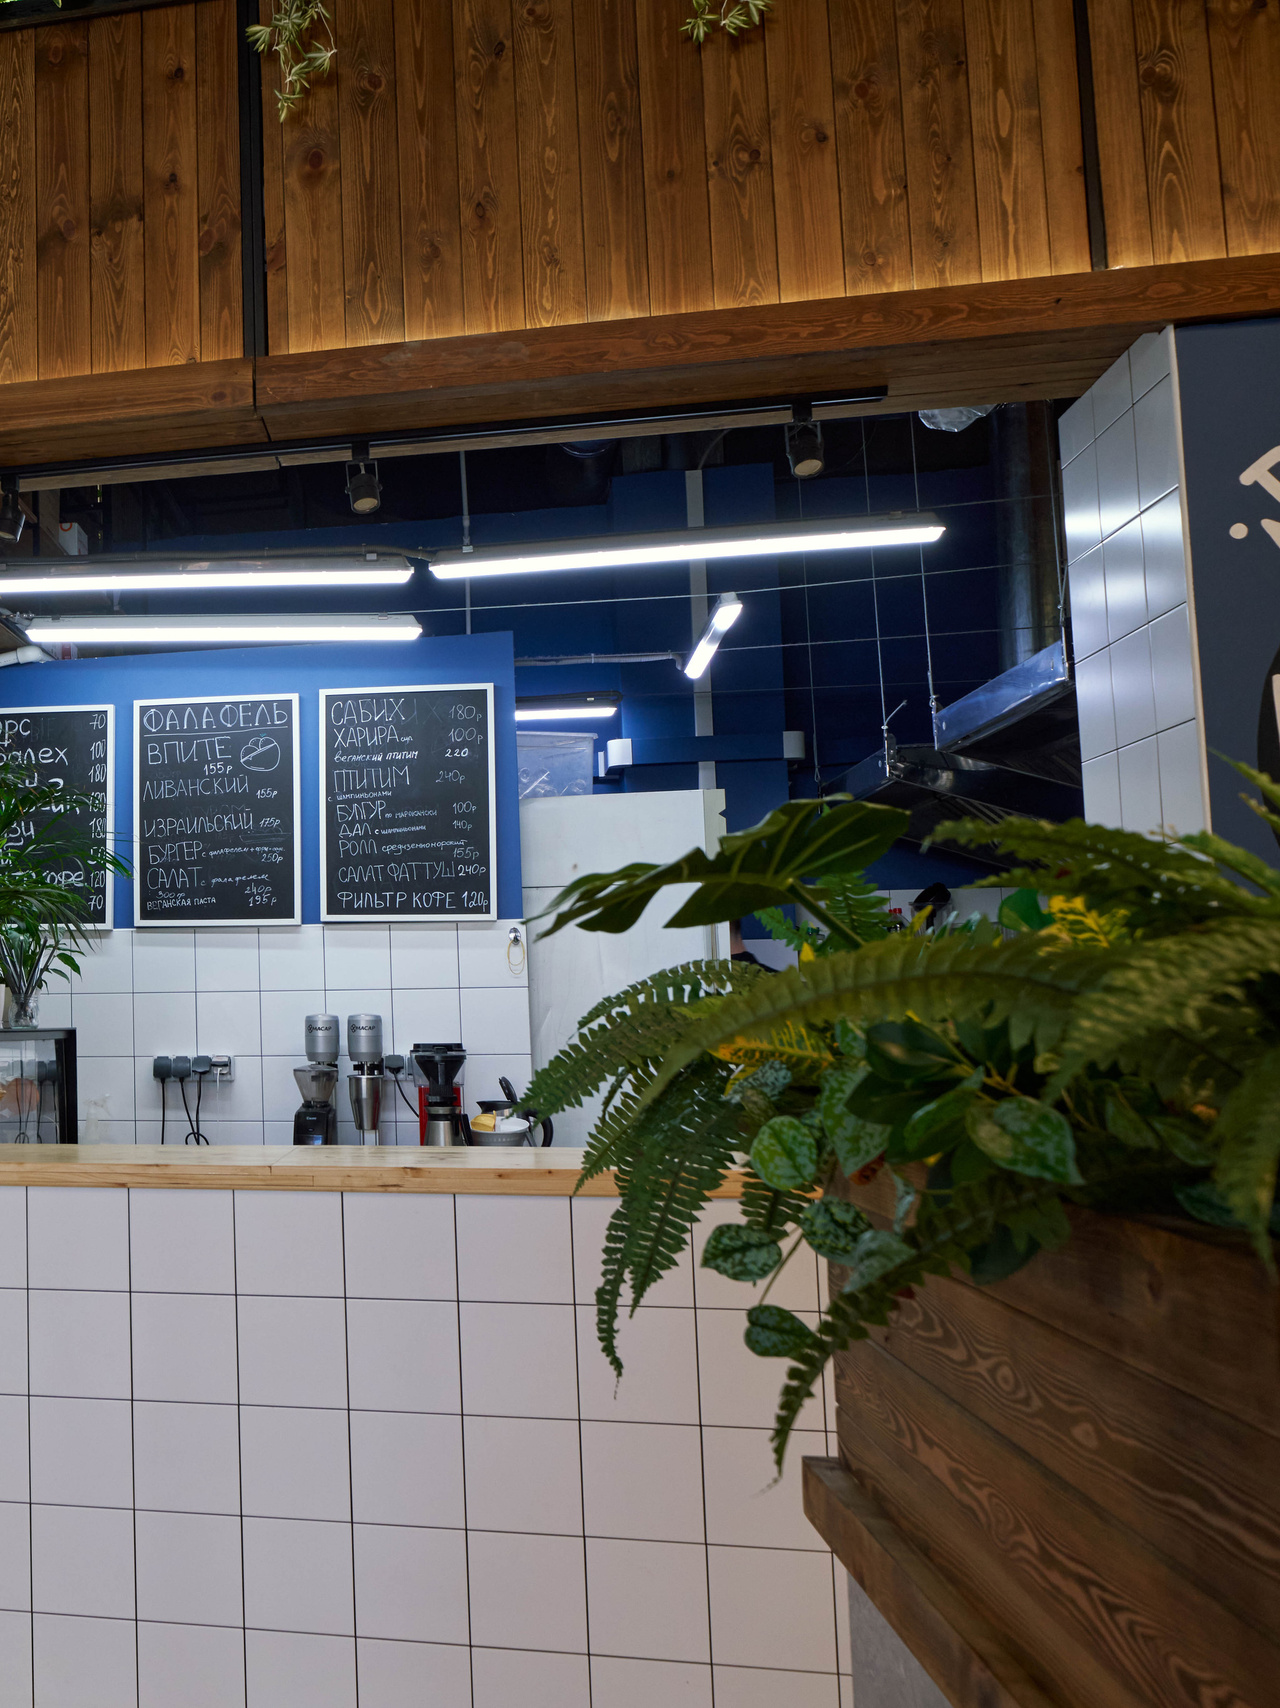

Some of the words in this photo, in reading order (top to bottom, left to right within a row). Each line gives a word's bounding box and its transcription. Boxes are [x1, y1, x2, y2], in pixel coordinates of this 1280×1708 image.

[89, 714, 106, 730] 70
[143, 703, 288, 732] ФАЛАФЕЛЬ
[331, 698, 406, 726] САБИХ
[333, 724, 399, 748] ХАРИРА
[89, 739, 106, 761] 100
[444, 747, 469, 758] 220
[88, 763, 107, 783] 180
[333, 765, 410, 792] ПТИТИМ
[143, 774, 249, 802] ЛИВАНСКИЙ
[336, 800, 387, 822] БУЛГУР
[144, 808, 253, 837] ИЗРАИЛЬСКИЙ
[338, 823, 372, 838] ДАЛ
[148, 841, 203, 865] БУРГЕР
[338, 839, 378, 858] РОЛЛ
[89, 870, 105, 888] 120
[147, 867, 203, 889] САЛАТ
[338, 864, 384, 883] САЛАТ
[387, 861, 456, 882] ФАТТУШ
[87, 895, 104, 912] 70
[336, 891, 408, 909] ФИЛЬТР
[412, 891, 457, 909] КОФЕ
